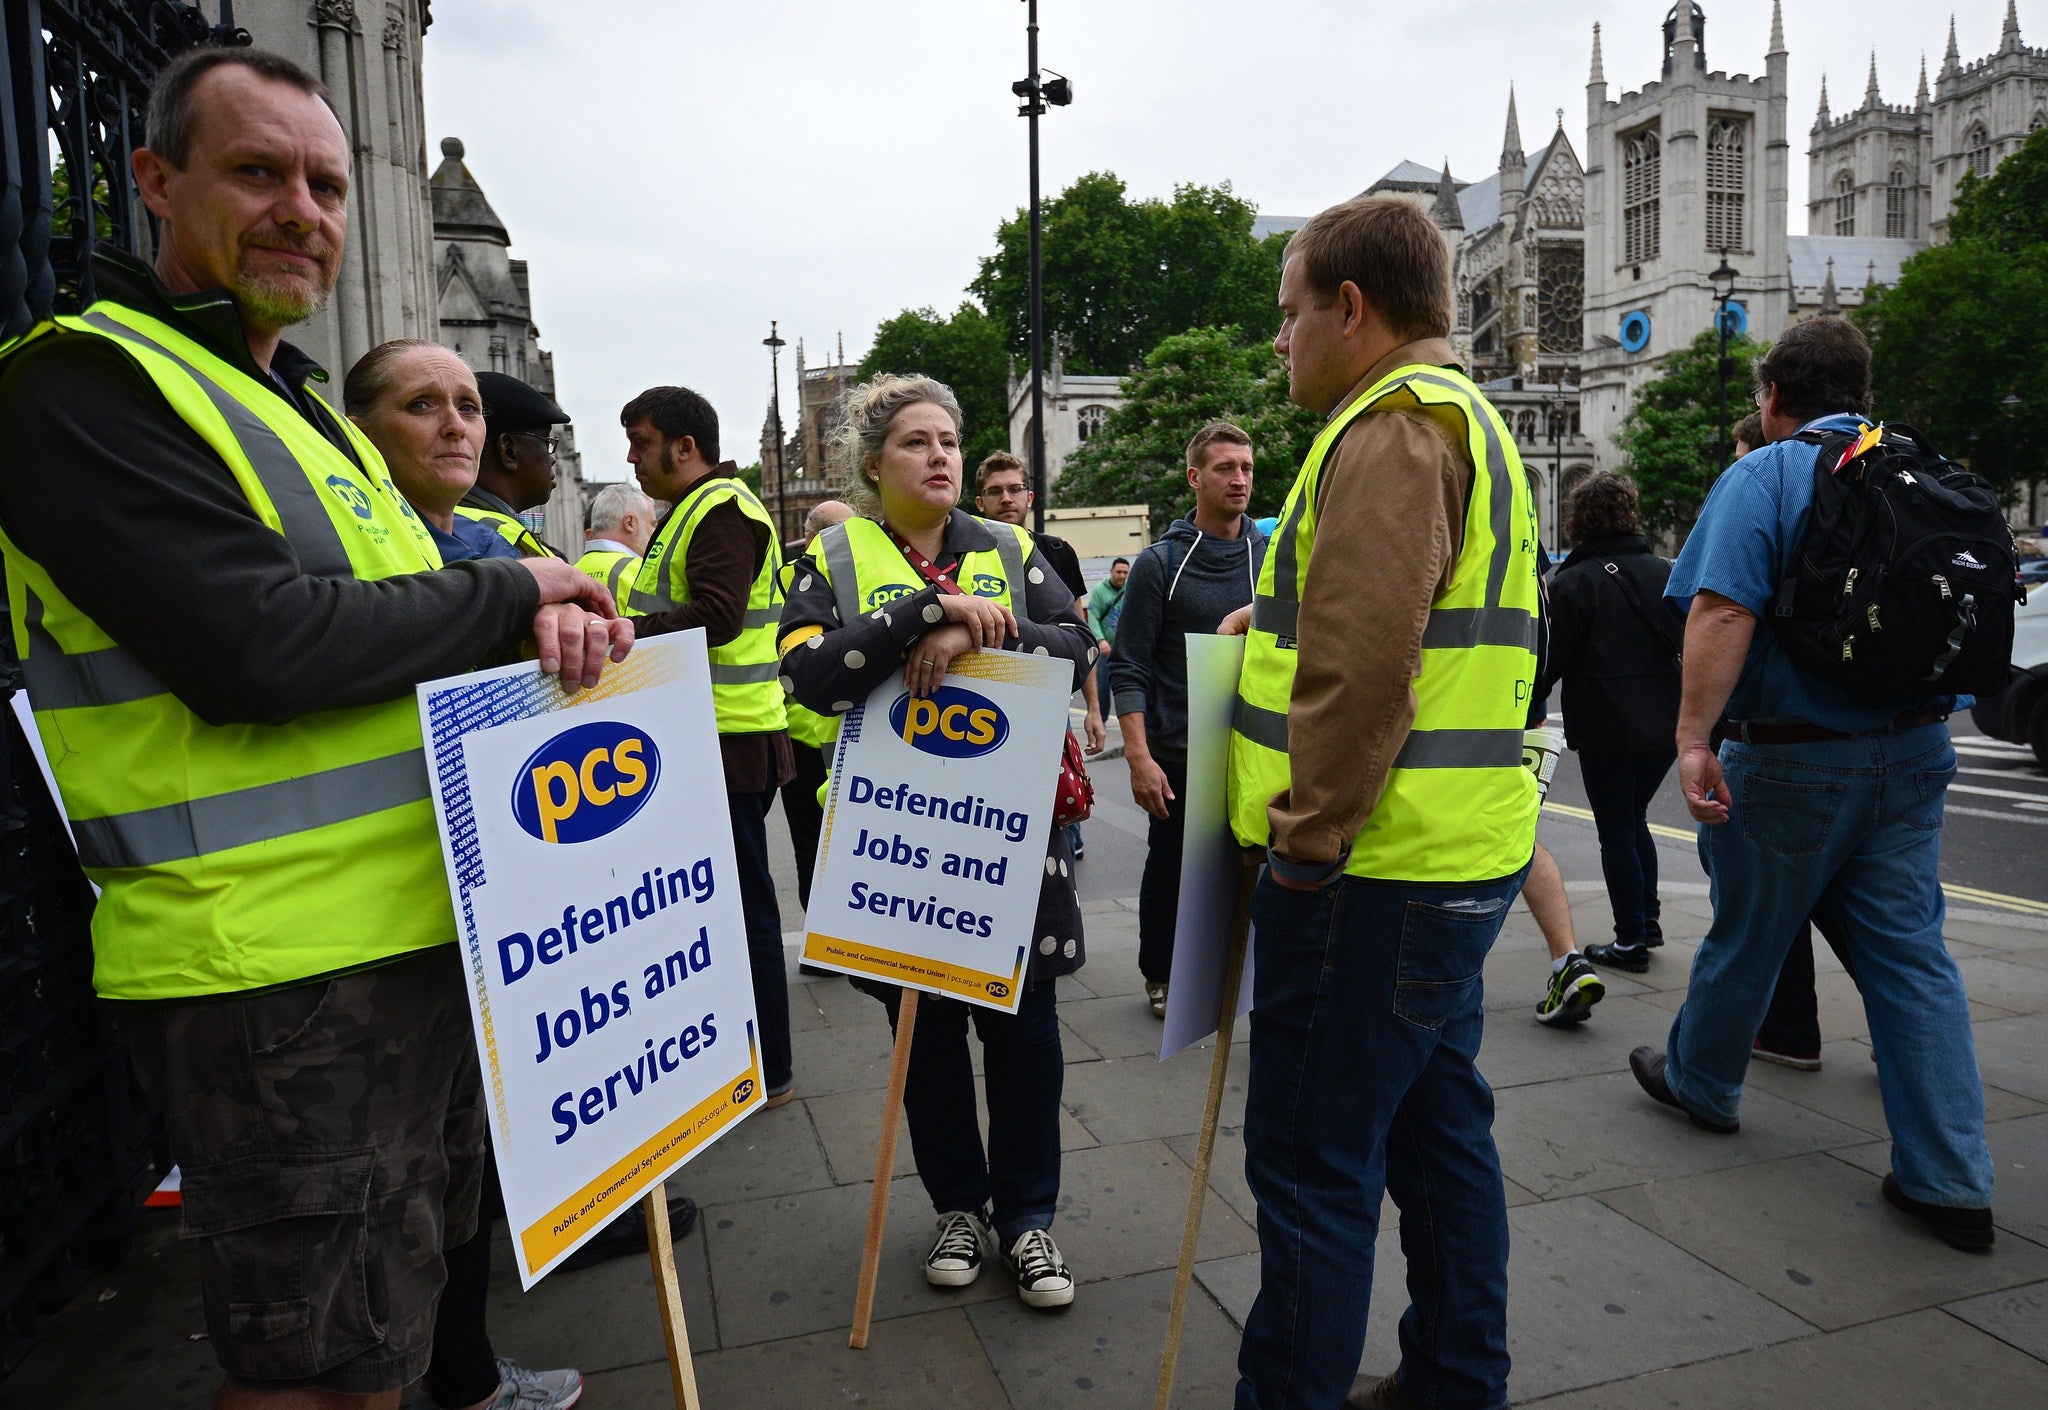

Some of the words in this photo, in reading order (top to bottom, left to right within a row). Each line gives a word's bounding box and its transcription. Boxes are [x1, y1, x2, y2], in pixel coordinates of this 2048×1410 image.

[902, 696, 997, 746] pcs
[531, 738, 648, 844] pcs
[848, 775, 1029, 842] Defending
[853, 829, 930, 869] Jobs
[941, 856, 1008, 886] and
[497, 856, 715, 986] Defending
[848, 881, 994, 938] Services
[826, 946, 846, 957] Public
[846, 951, 859, 960] and
[860, 954, 898, 968] Commercial
[926, 968, 946, 978] Union
[988, 984, 1008, 996] pcs
[535, 980, 630, 1064] Jobs
[644, 926, 712, 999] and
[551, 1013, 717, 1145] Services
[734, 1080, 752, 1104] pcs
[553, 1212, 579, 1236] Public
[580, 1198, 595, 1216] and
[596, 1164, 641, 1202] Commercial
[642, 1144, 670, 1169] Services
[671, 1128, 691, 1147] Union
[697, 1100, 728, 1129] pcs.org.uk
